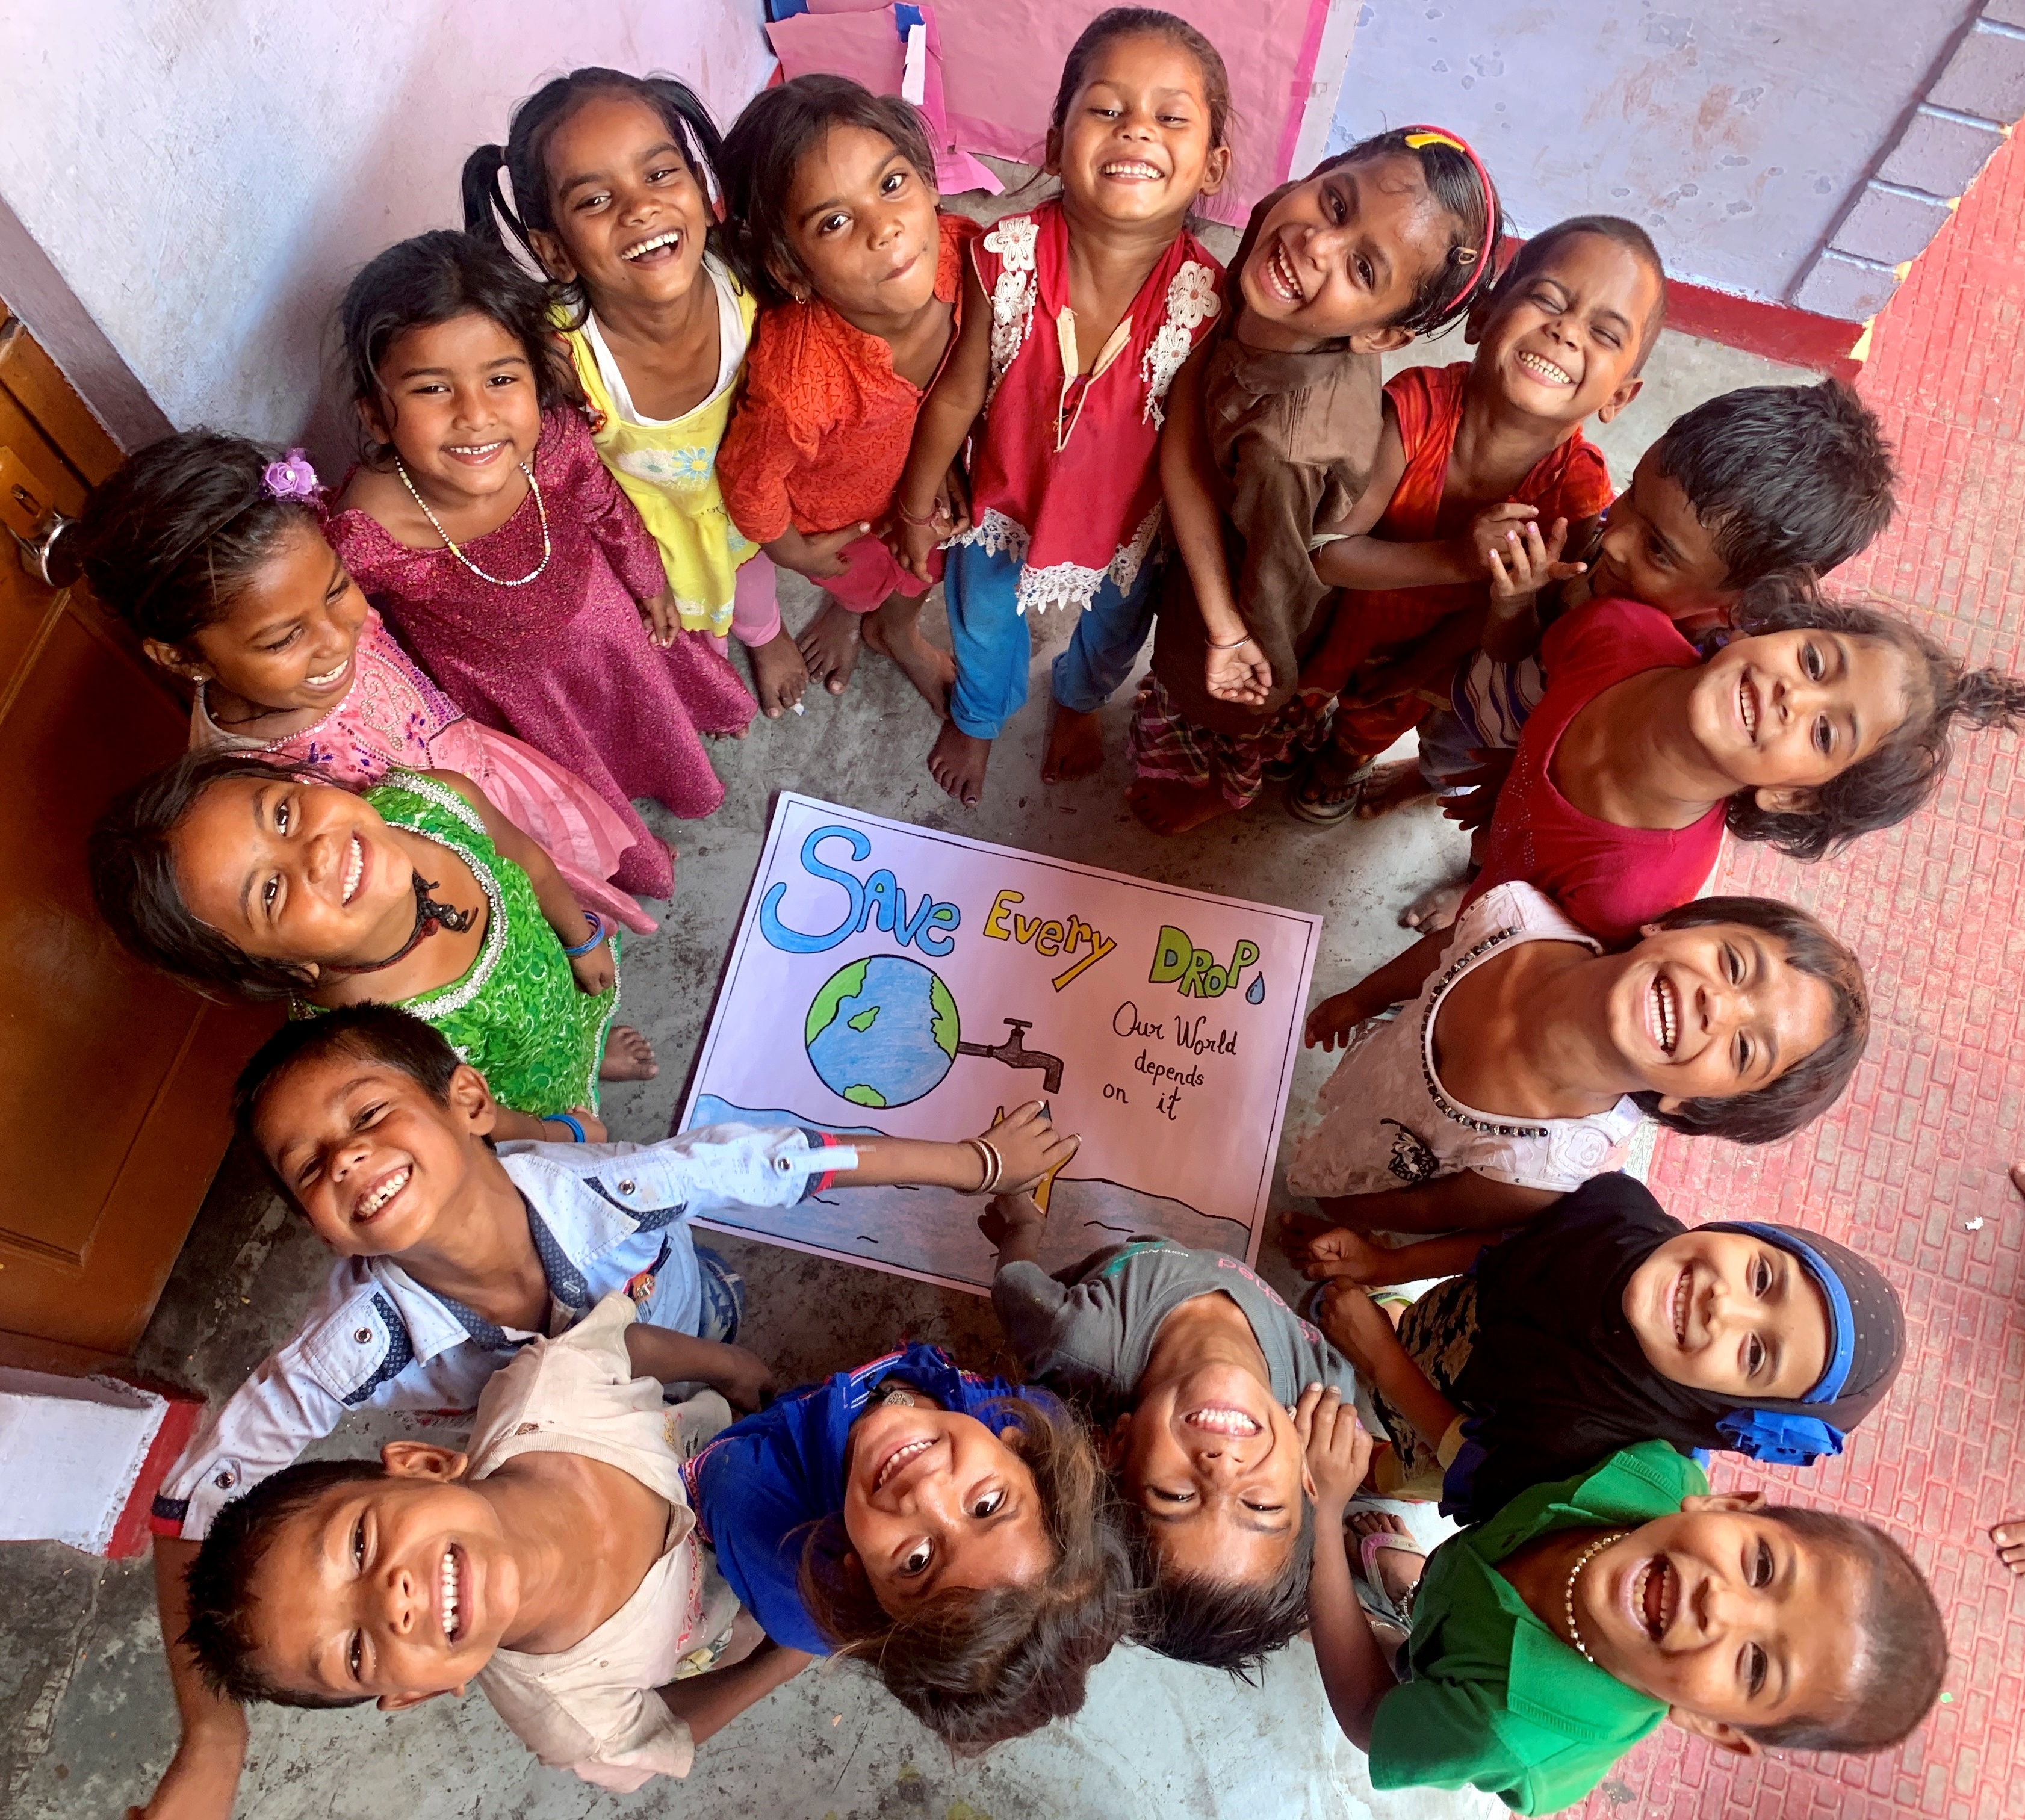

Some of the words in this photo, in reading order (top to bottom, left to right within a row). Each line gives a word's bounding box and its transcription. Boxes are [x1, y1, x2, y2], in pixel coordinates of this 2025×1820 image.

[983, 889, 1117, 993] Every
[1112, 1000, 1165, 1040] Our
[1174, 1015, 1238, 1056] World
[1134, 1048, 1205, 1087] depends
[1103, 1083, 1129, 1104] on
[1156, 1086, 1182, 1121] it
